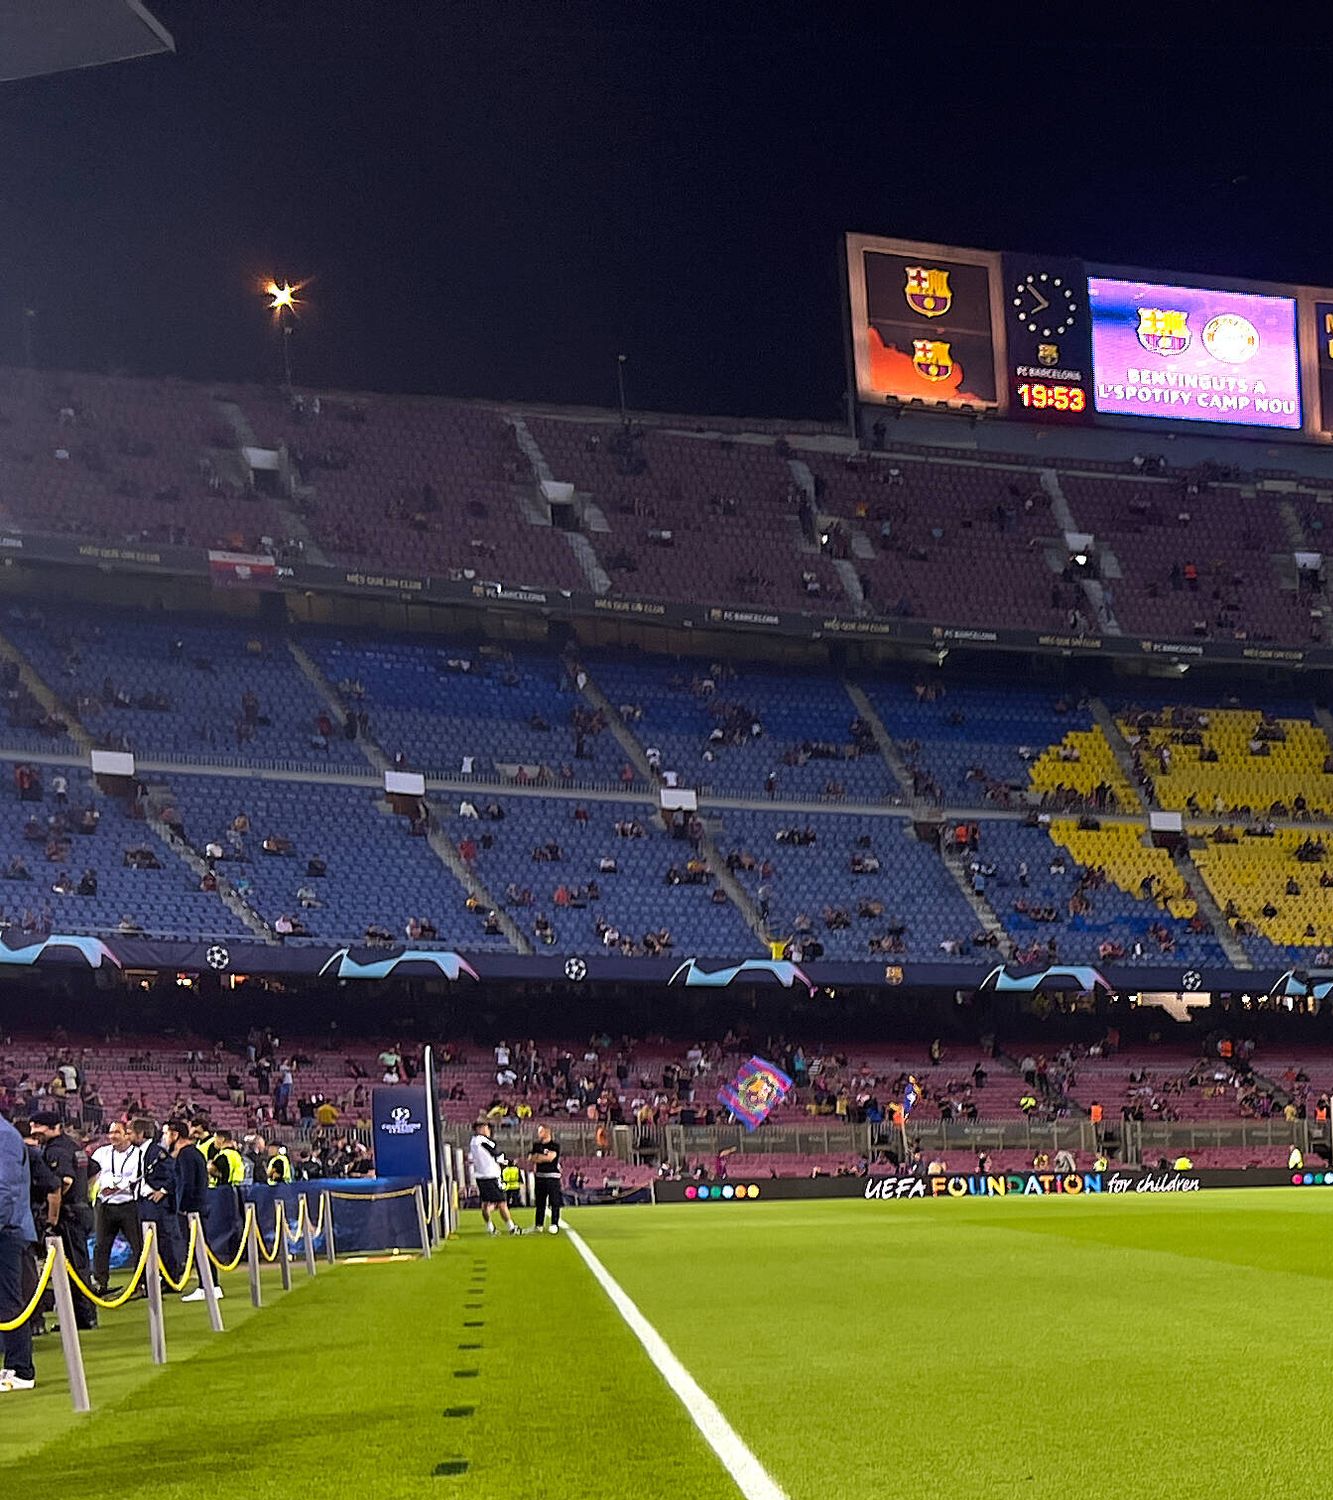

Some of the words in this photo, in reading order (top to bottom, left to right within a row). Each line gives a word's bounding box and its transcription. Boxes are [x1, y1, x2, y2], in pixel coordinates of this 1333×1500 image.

[1127, 368, 1248, 394] BENVINGUTS
[1253, 379, 1266, 395] A
[1017, 384, 1086, 412] 19:53
[1196, 392, 1251, 413] CAMP
[1254, 398, 1295, 415] NOU
[865, 1176, 926, 1199] UEFA
[1107, 1172, 1132, 1193] for
[1136, 1172, 1199, 1193] children
